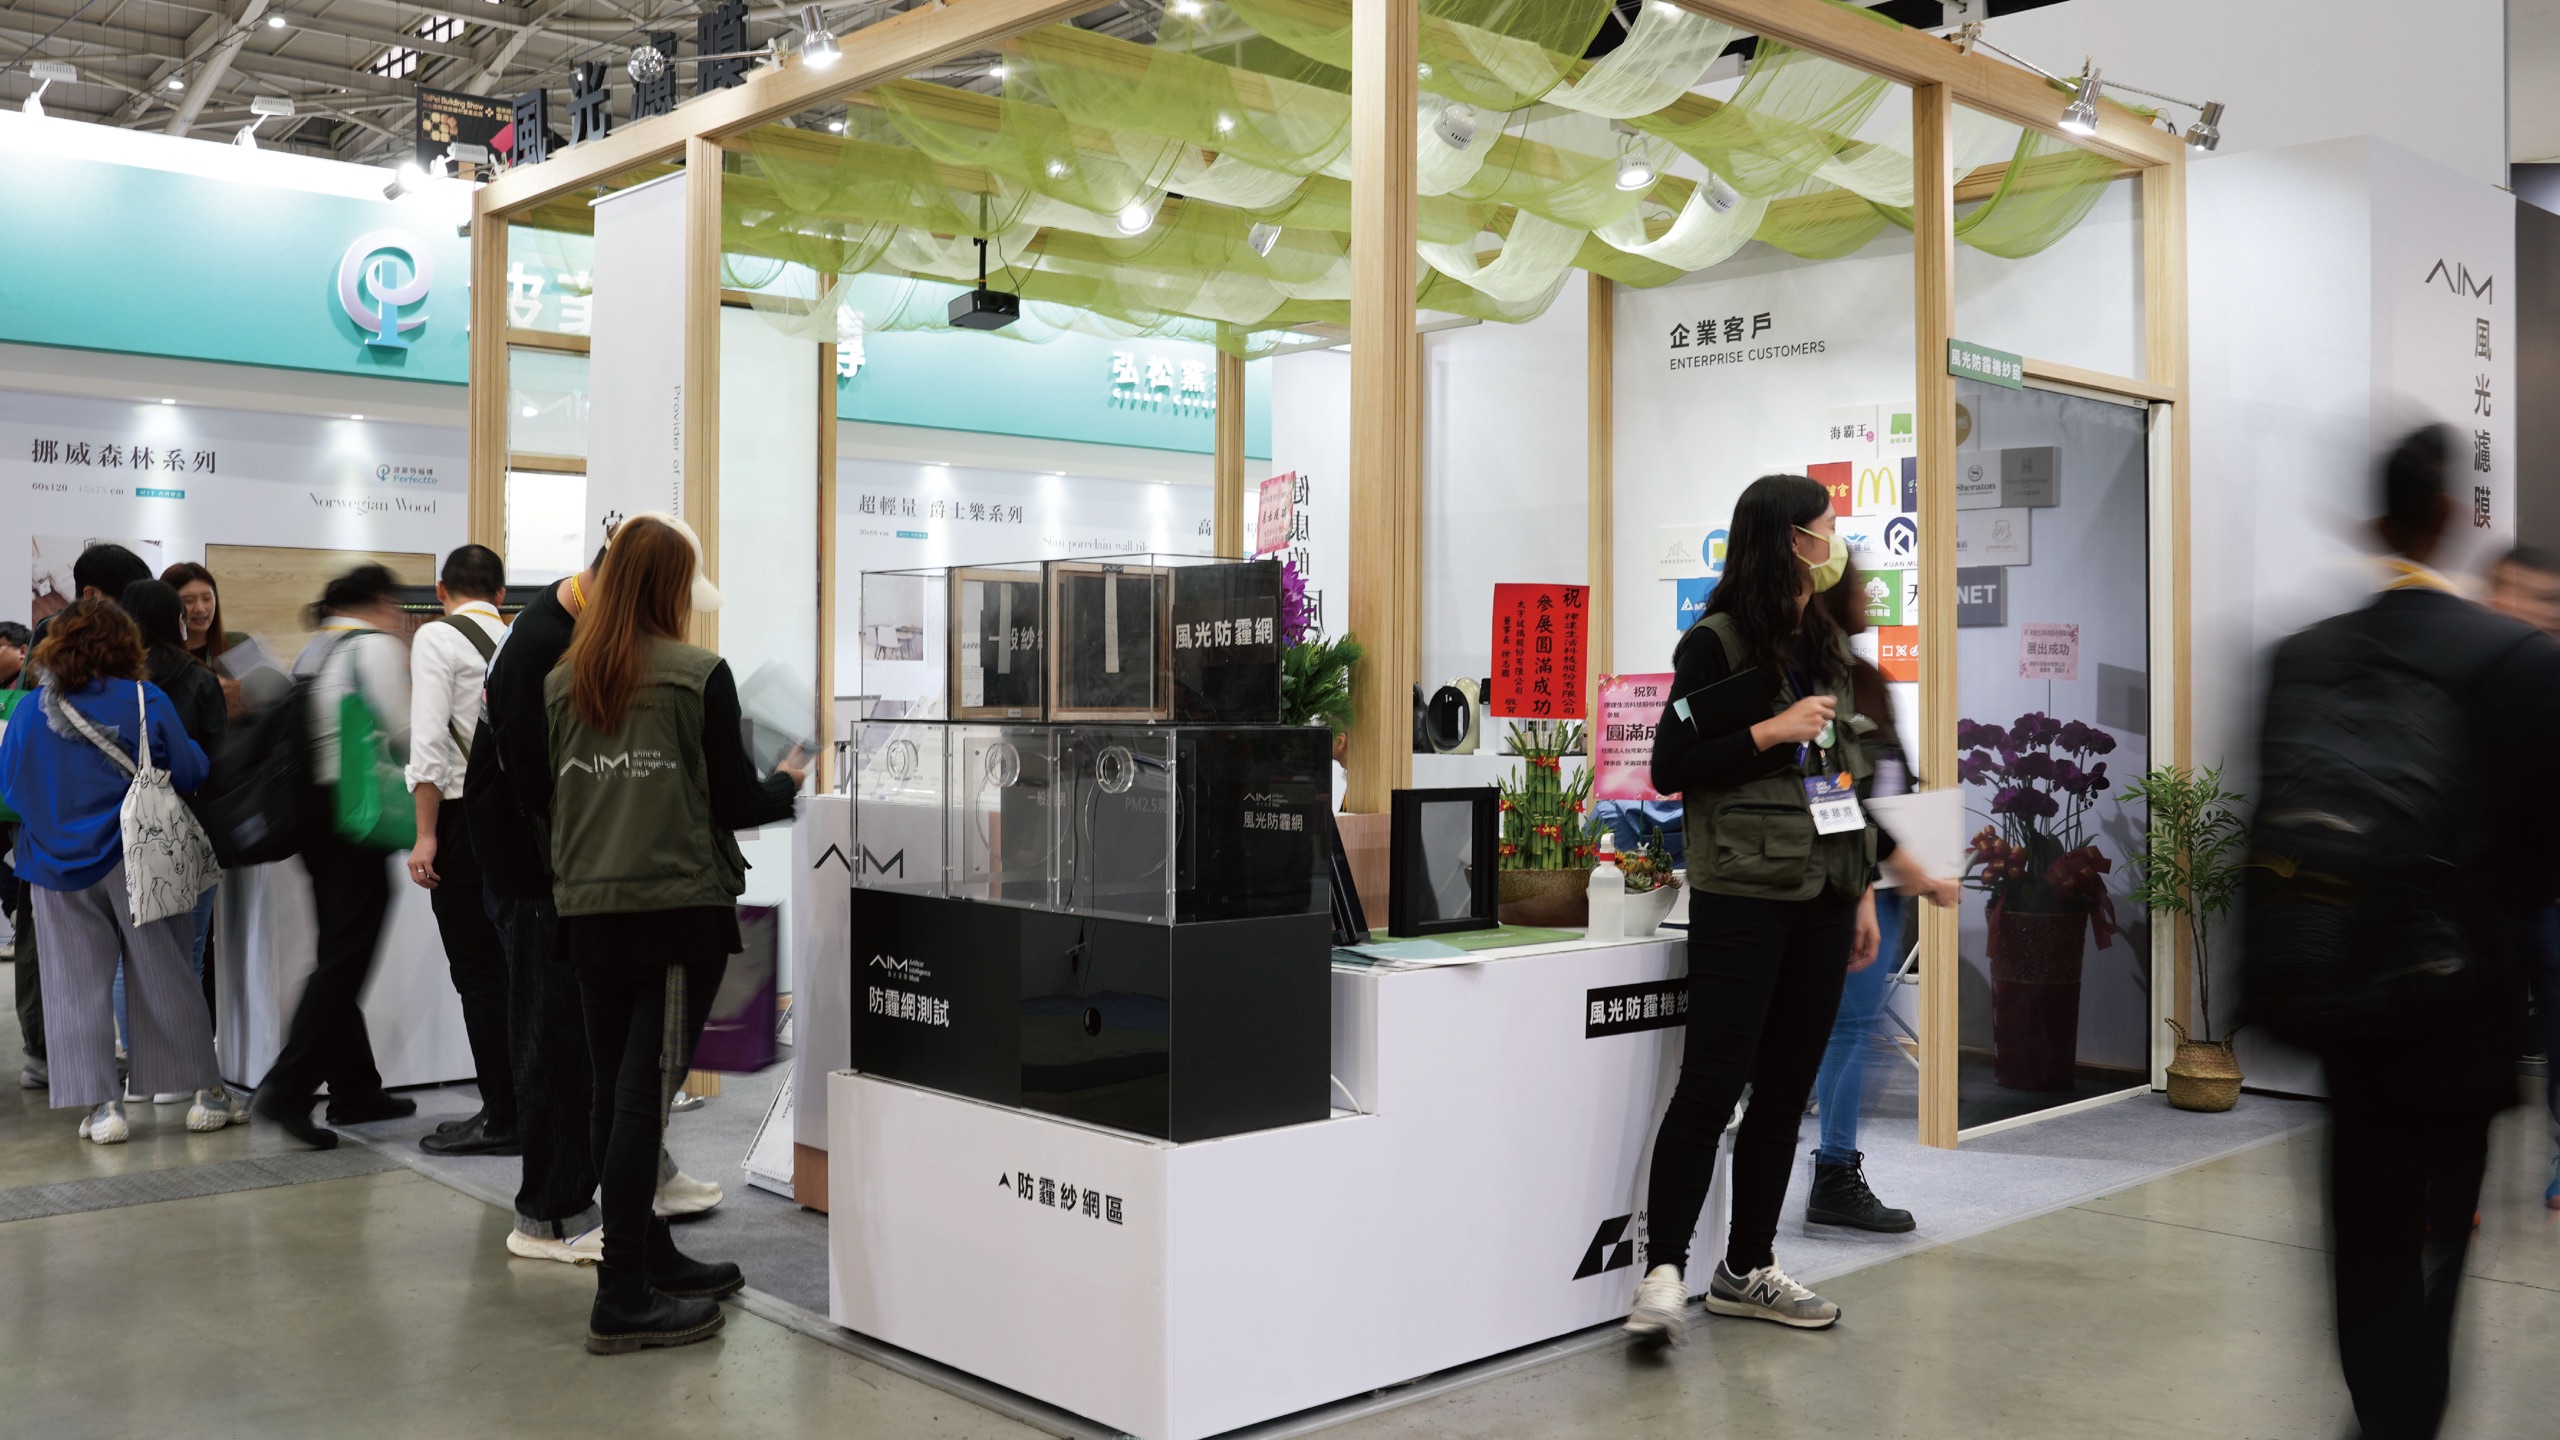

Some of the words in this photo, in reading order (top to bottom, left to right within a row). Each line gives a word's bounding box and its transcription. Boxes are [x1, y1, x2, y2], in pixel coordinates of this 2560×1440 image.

[2425, 258, 2493, 305] AIM
[1670, 312, 1772, 349] 企業客戶
[1670, 351, 1743, 370] ENTERPRISE
[1748, 340, 1826, 361] CUSTOMERS
[673, 385, 682, 452] Provider
[2473, 317, 2492, 530] 風光濾膜
[31, 438, 217, 474] 挪威森林系列
[673, 459, 681, 475] of
[393, 474, 439, 486] Perfectto
[309, 492, 389, 516] Norwegian
[395, 497, 437, 514] Wood
[1563, 588, 1582, 608] 祝
[1175, 617, 1274, 650] 風光防霾網
[1634, 686, 1658, 698] 祝賀
[1243, 810, 1304, 832] 風光防霾網
[869, 954, 908, 973] AIM
[869, 986, 950, 1028] 防霾網測試
[1017, 1171, 1124, 1226] 防霾紗網區
